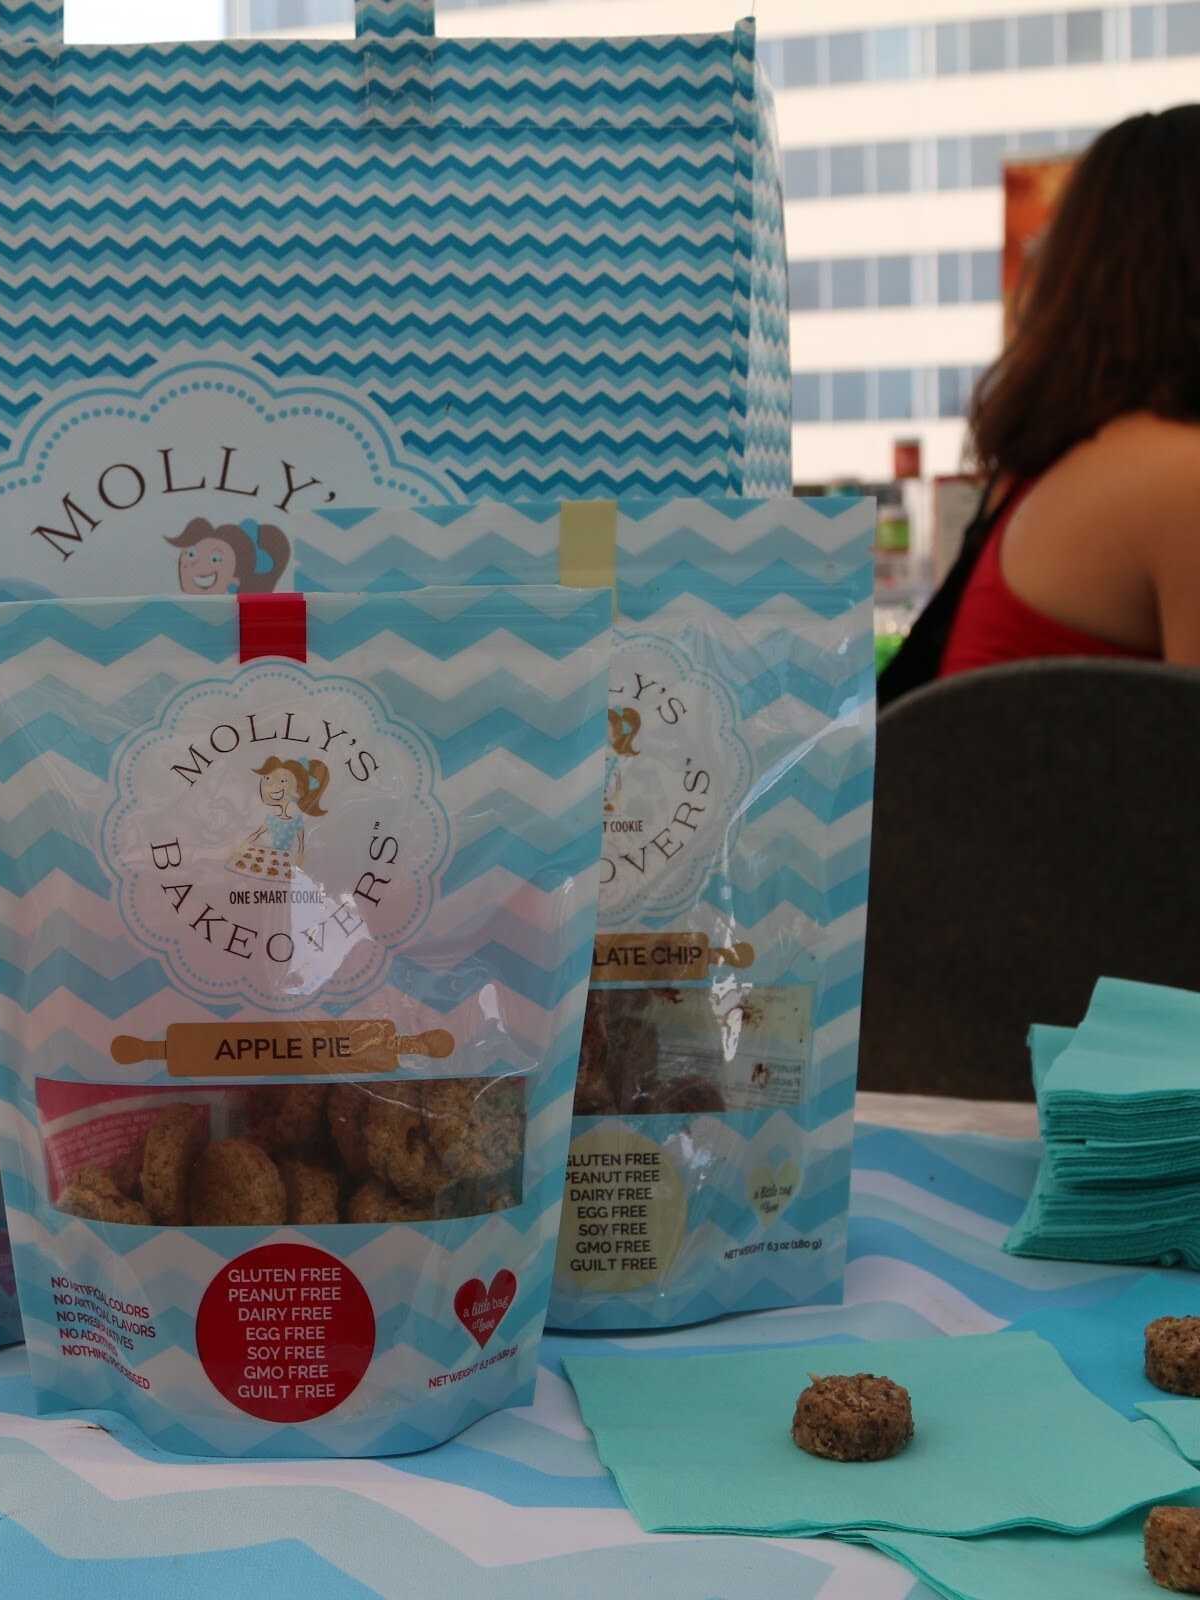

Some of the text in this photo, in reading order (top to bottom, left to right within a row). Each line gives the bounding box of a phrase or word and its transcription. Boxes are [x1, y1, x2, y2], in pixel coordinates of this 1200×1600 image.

[30, 445, 337, 562] MOLLY'
[169, 712, 380, 787] MOLLY'S
[610, 820, 643, 833] COOKIE
[229, 891, 250, 904] ONE
[253, 891, 287, 904] SMART
[651, 946, 702, 965] CHIP
[214, 1036, 352, 1060] APPLE PIE
[625, 1152, 660, 1165] FREE
[625, 1170, 660, 1183] FREE
[570, 1188, 653, 1202] DAIRY FREE
[578, 1205, 647, 1219] EGG FREE
[579, 1223, 647, 1237] SOY FREE
[576, 1240, 651, 1254] GMO FREE
[724, 1250, 737, 1260] NET
[739, 1242, 765, 1256] WEIGHT
[812, 1239, 822, 1251] g)
[570, 1258, 657, 1272] GUILT FREE
[228, 1268, 342, 1283] GLUTEN FREE
[51, 1276, 150, 1319] NO ARTIFICIAL COLORS
[228, 1287, 342, 1303] PEANUT FREE
[238, 1307, 332, 1322] DAIRY FREE
[463, 1296, 510, 1318] a little bag
[53, 1294, 156, 1338] NO ARTIFICIAL FLAVORS
[56, 1311, 76, 1322] NO
[478, 1318, 495, 1332] love
[59, 1328, 79, 1339] NO
[246, 1326, 325, 1340] EGG FREE
[62, 1345, 110, 1363] NOTHING
[247, 1346, 325, 1360] SOY FREE
[244, 1365, 328, 1380] GMO FREE
[428, 1374, 449, 1388] NET
[448, 1363, 479, 1383] WEIGHT
[238, 1384, 336, 1399] GUILT FREE
